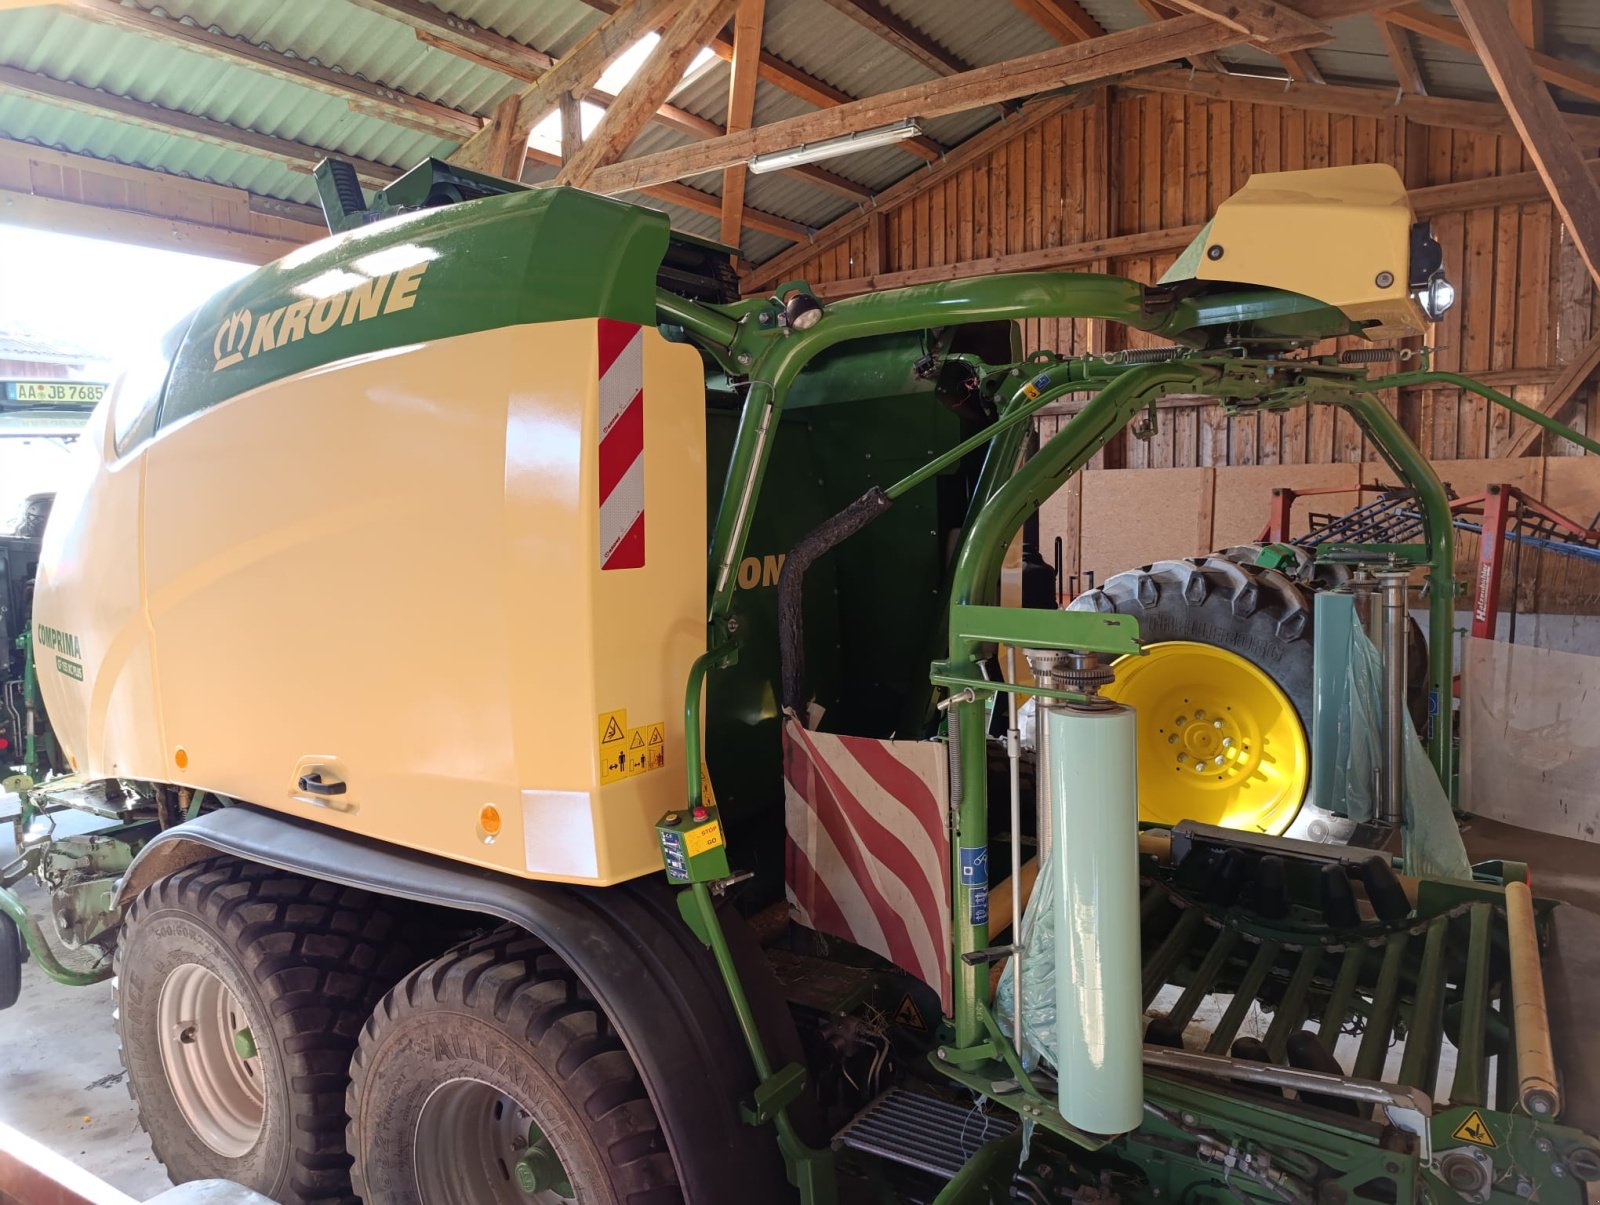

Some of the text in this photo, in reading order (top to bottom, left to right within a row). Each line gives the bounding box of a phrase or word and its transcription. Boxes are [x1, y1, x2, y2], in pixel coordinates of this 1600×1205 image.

[248, 262, 429, 358] KRONE
[18, 385, 104, 400] AA JB 7685
[735, 554, 786, 590] ON
[38, 624, 81, 660] COMPRIMA
[701, 826, 717, 837] STOP
[707, 837, 717, 846] GO
